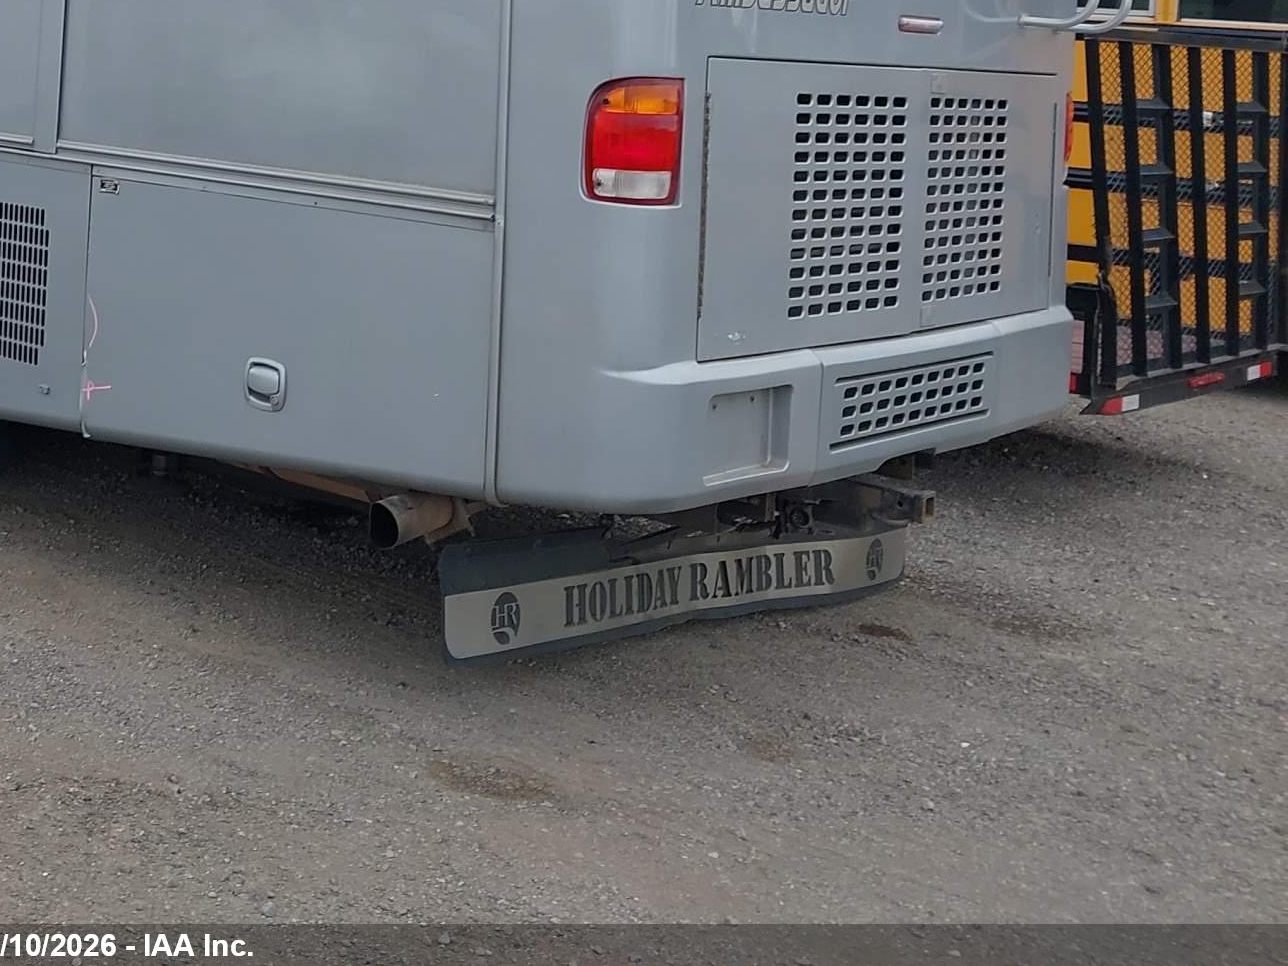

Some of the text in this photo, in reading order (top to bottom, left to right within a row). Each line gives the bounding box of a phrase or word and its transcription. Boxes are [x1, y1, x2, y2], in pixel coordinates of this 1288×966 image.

[492, 602, 518, 628] HR
[563, 565, 683, 628] HOLIDAY
[688, 548, 836, 603] RAMBLER
